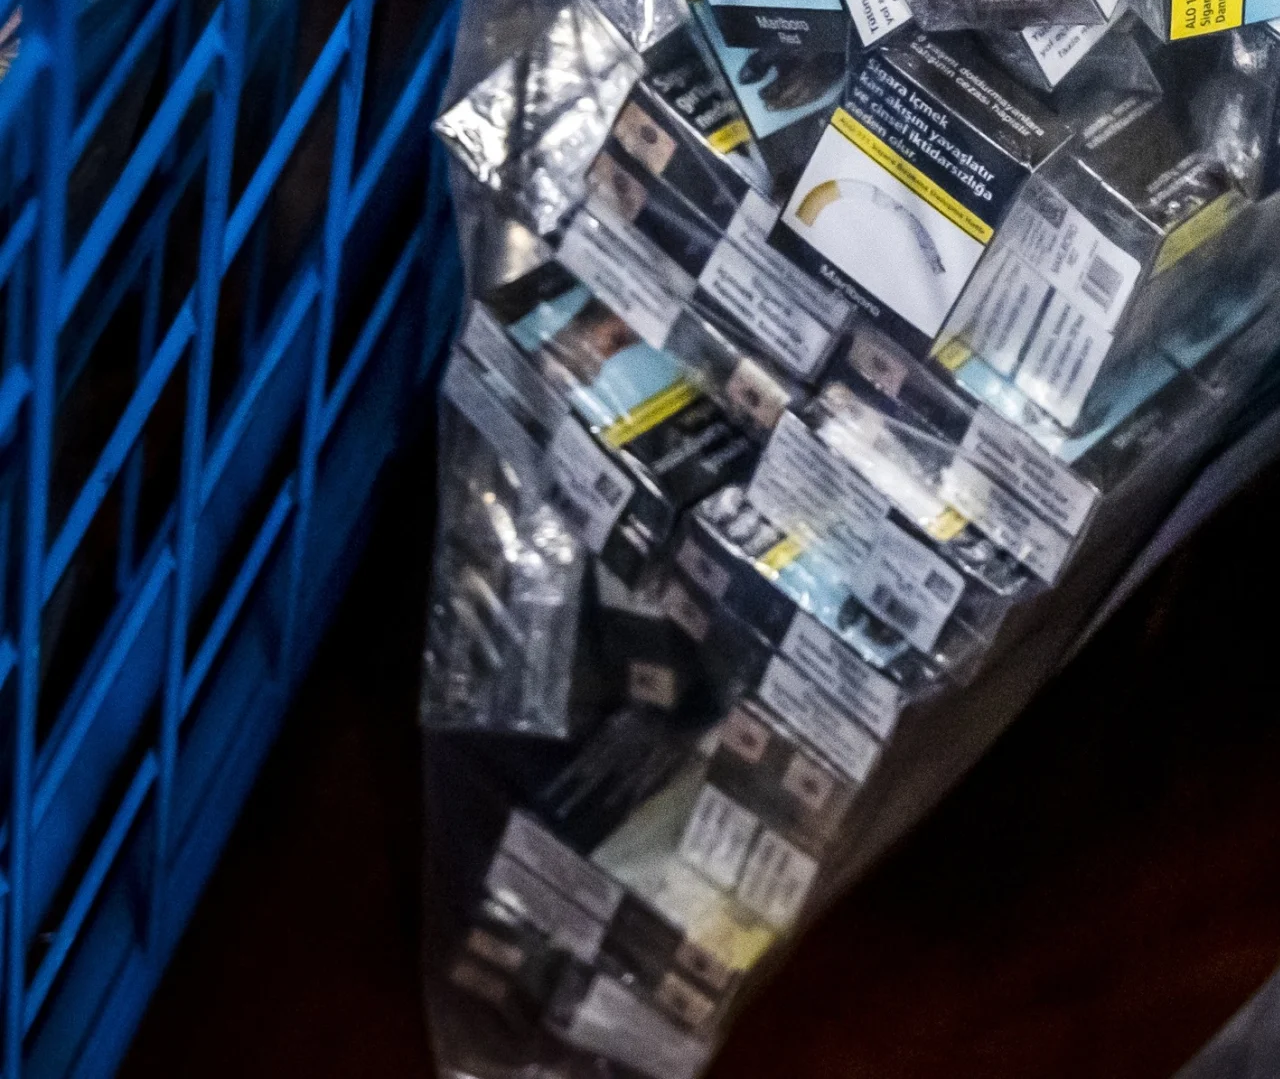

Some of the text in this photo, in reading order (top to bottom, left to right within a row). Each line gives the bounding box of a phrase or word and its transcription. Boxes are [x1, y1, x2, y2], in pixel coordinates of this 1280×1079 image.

[878, 4, 897, 26] yol
[1183, 7, 1197, 29] ALO
[855, 70, 999, 185] kan akışını yavaşlatır
[862, 56, 954, 130] Sigara içmek
[900, 128, 1000, 204] iktidarsızlığa
